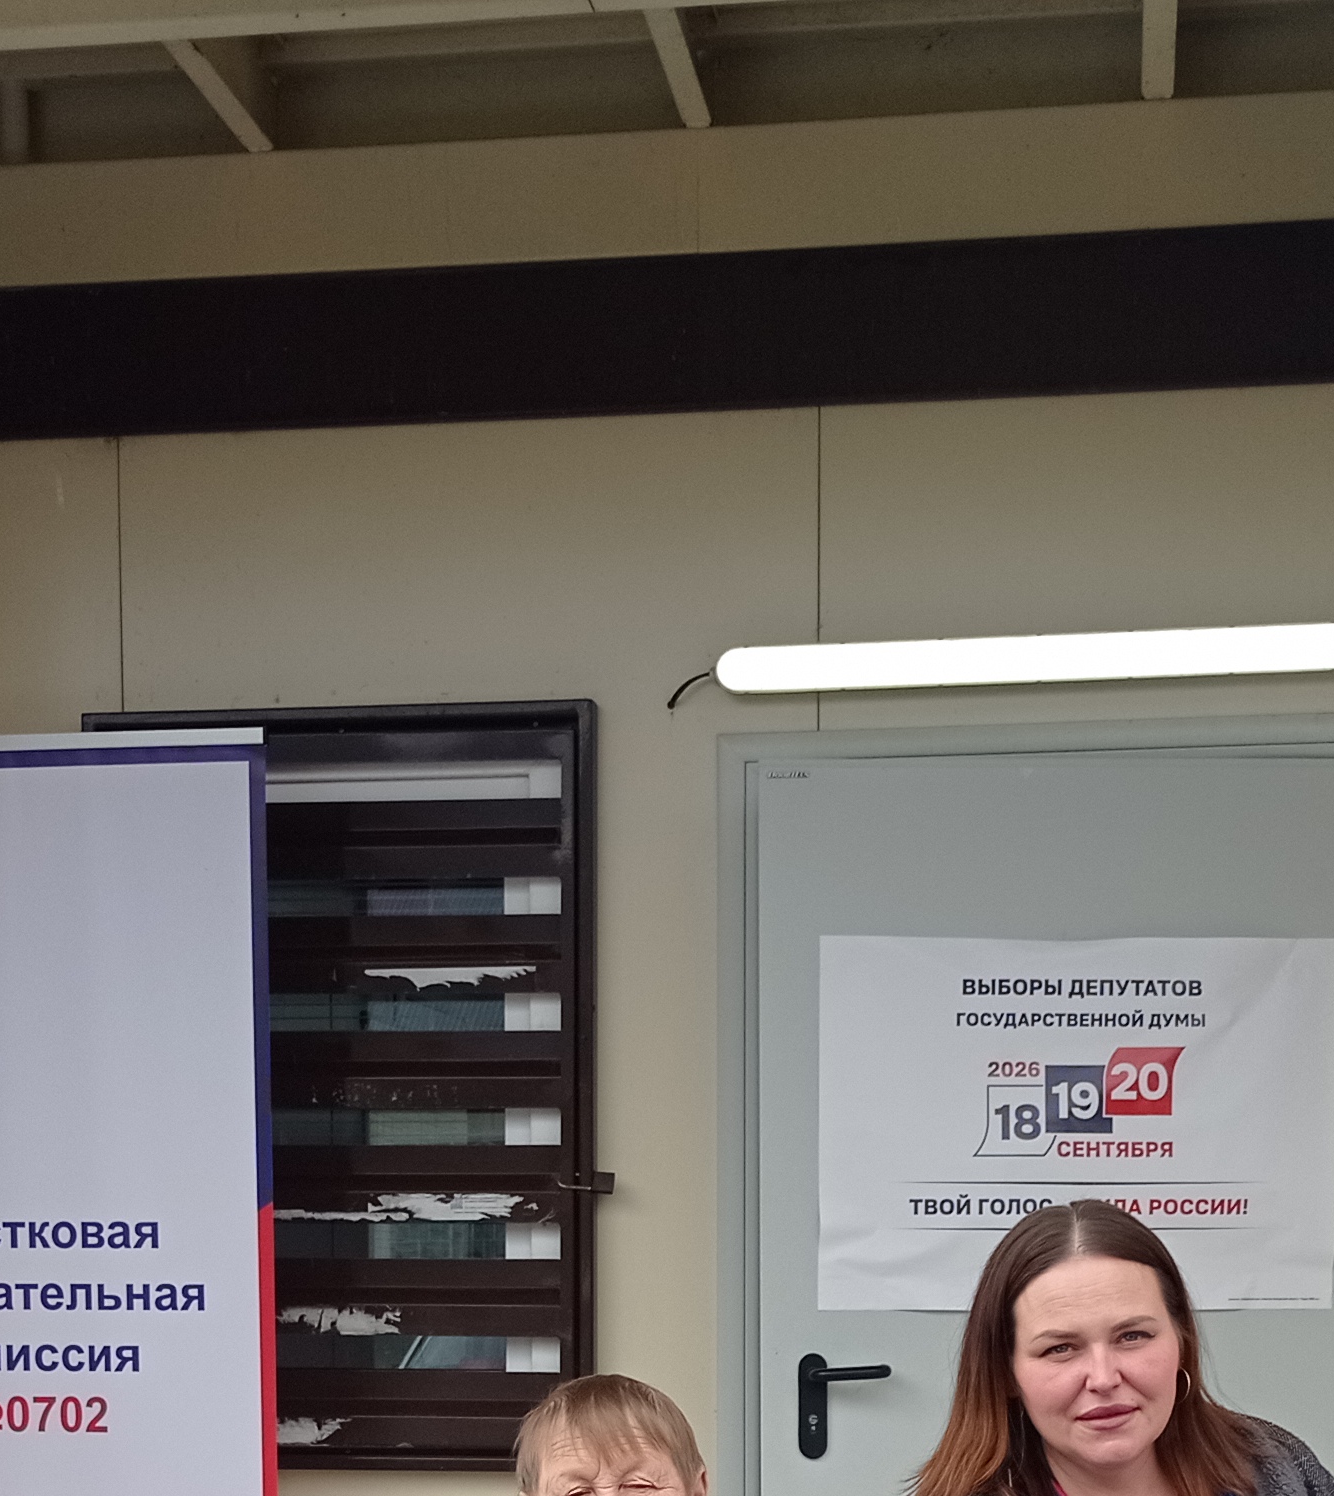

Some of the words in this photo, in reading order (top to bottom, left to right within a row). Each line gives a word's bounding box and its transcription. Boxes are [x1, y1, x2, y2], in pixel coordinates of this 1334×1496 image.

[961, 978, 1063, 998] ВЫБОРЫ
[1068, 979, 1203, 1000] ДЕПУТАТОВ
[956, 1008, 1144, 1029] ГОСУДАРСТВЕННОЙ
[1148, 1012, 1206, 1029] ДУМЫ
[987, 1061, 1041, 1078] 2026
[1110, 1062, 1168, 1101] 20
[1050, 1081, 1101, 1120] 19
[993, 1104, 1042, 1141] 18
[1056, 1140, 1175, 1159] СЕНТЯБРЯ
[909, 1194, 972, 1216] ТВОЙ
[1149, 1198, 1249, 1216] РОССИИ!
